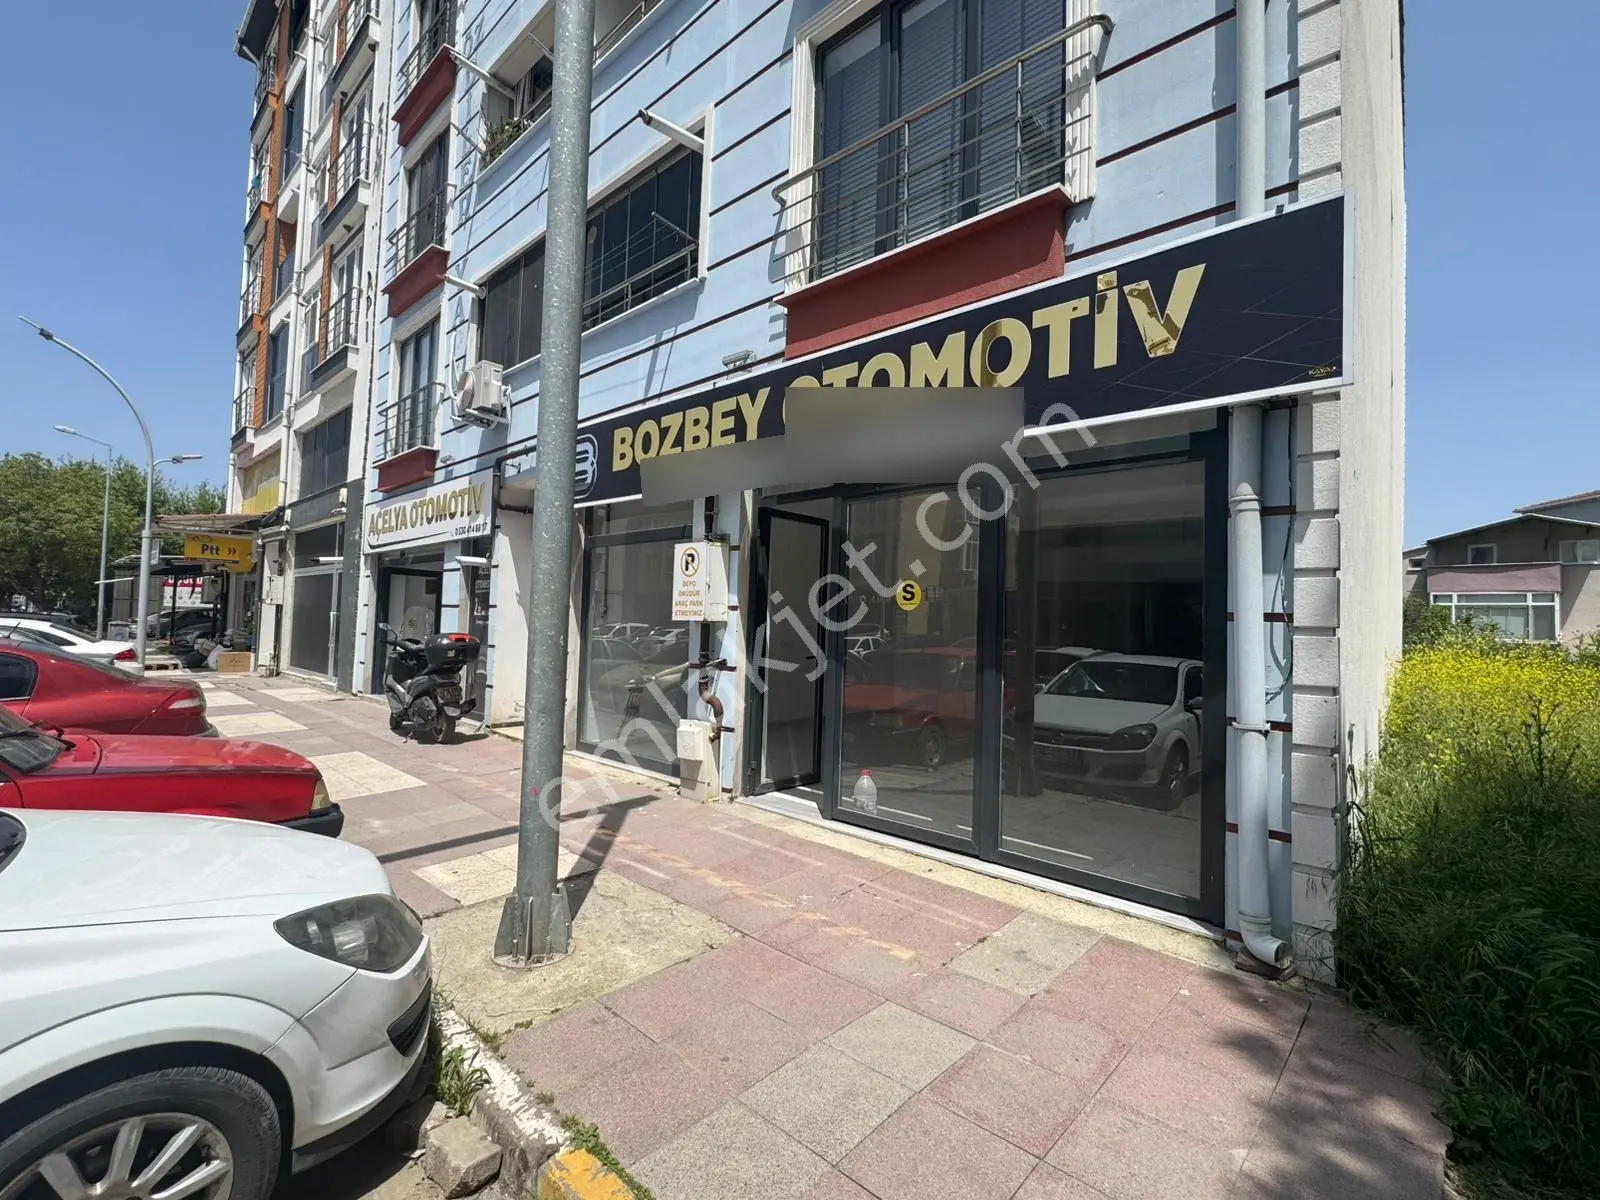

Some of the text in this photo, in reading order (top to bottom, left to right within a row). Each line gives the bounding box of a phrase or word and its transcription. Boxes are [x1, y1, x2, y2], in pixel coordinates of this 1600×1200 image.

[612, 263, 1207, 473] BOZBEY TOMOTİV
[368, 482, 486, 541] AÇELYA OTOMOTİV
[201, 543, 220, 555] Ptt
[902, 584, 915, 601] S
